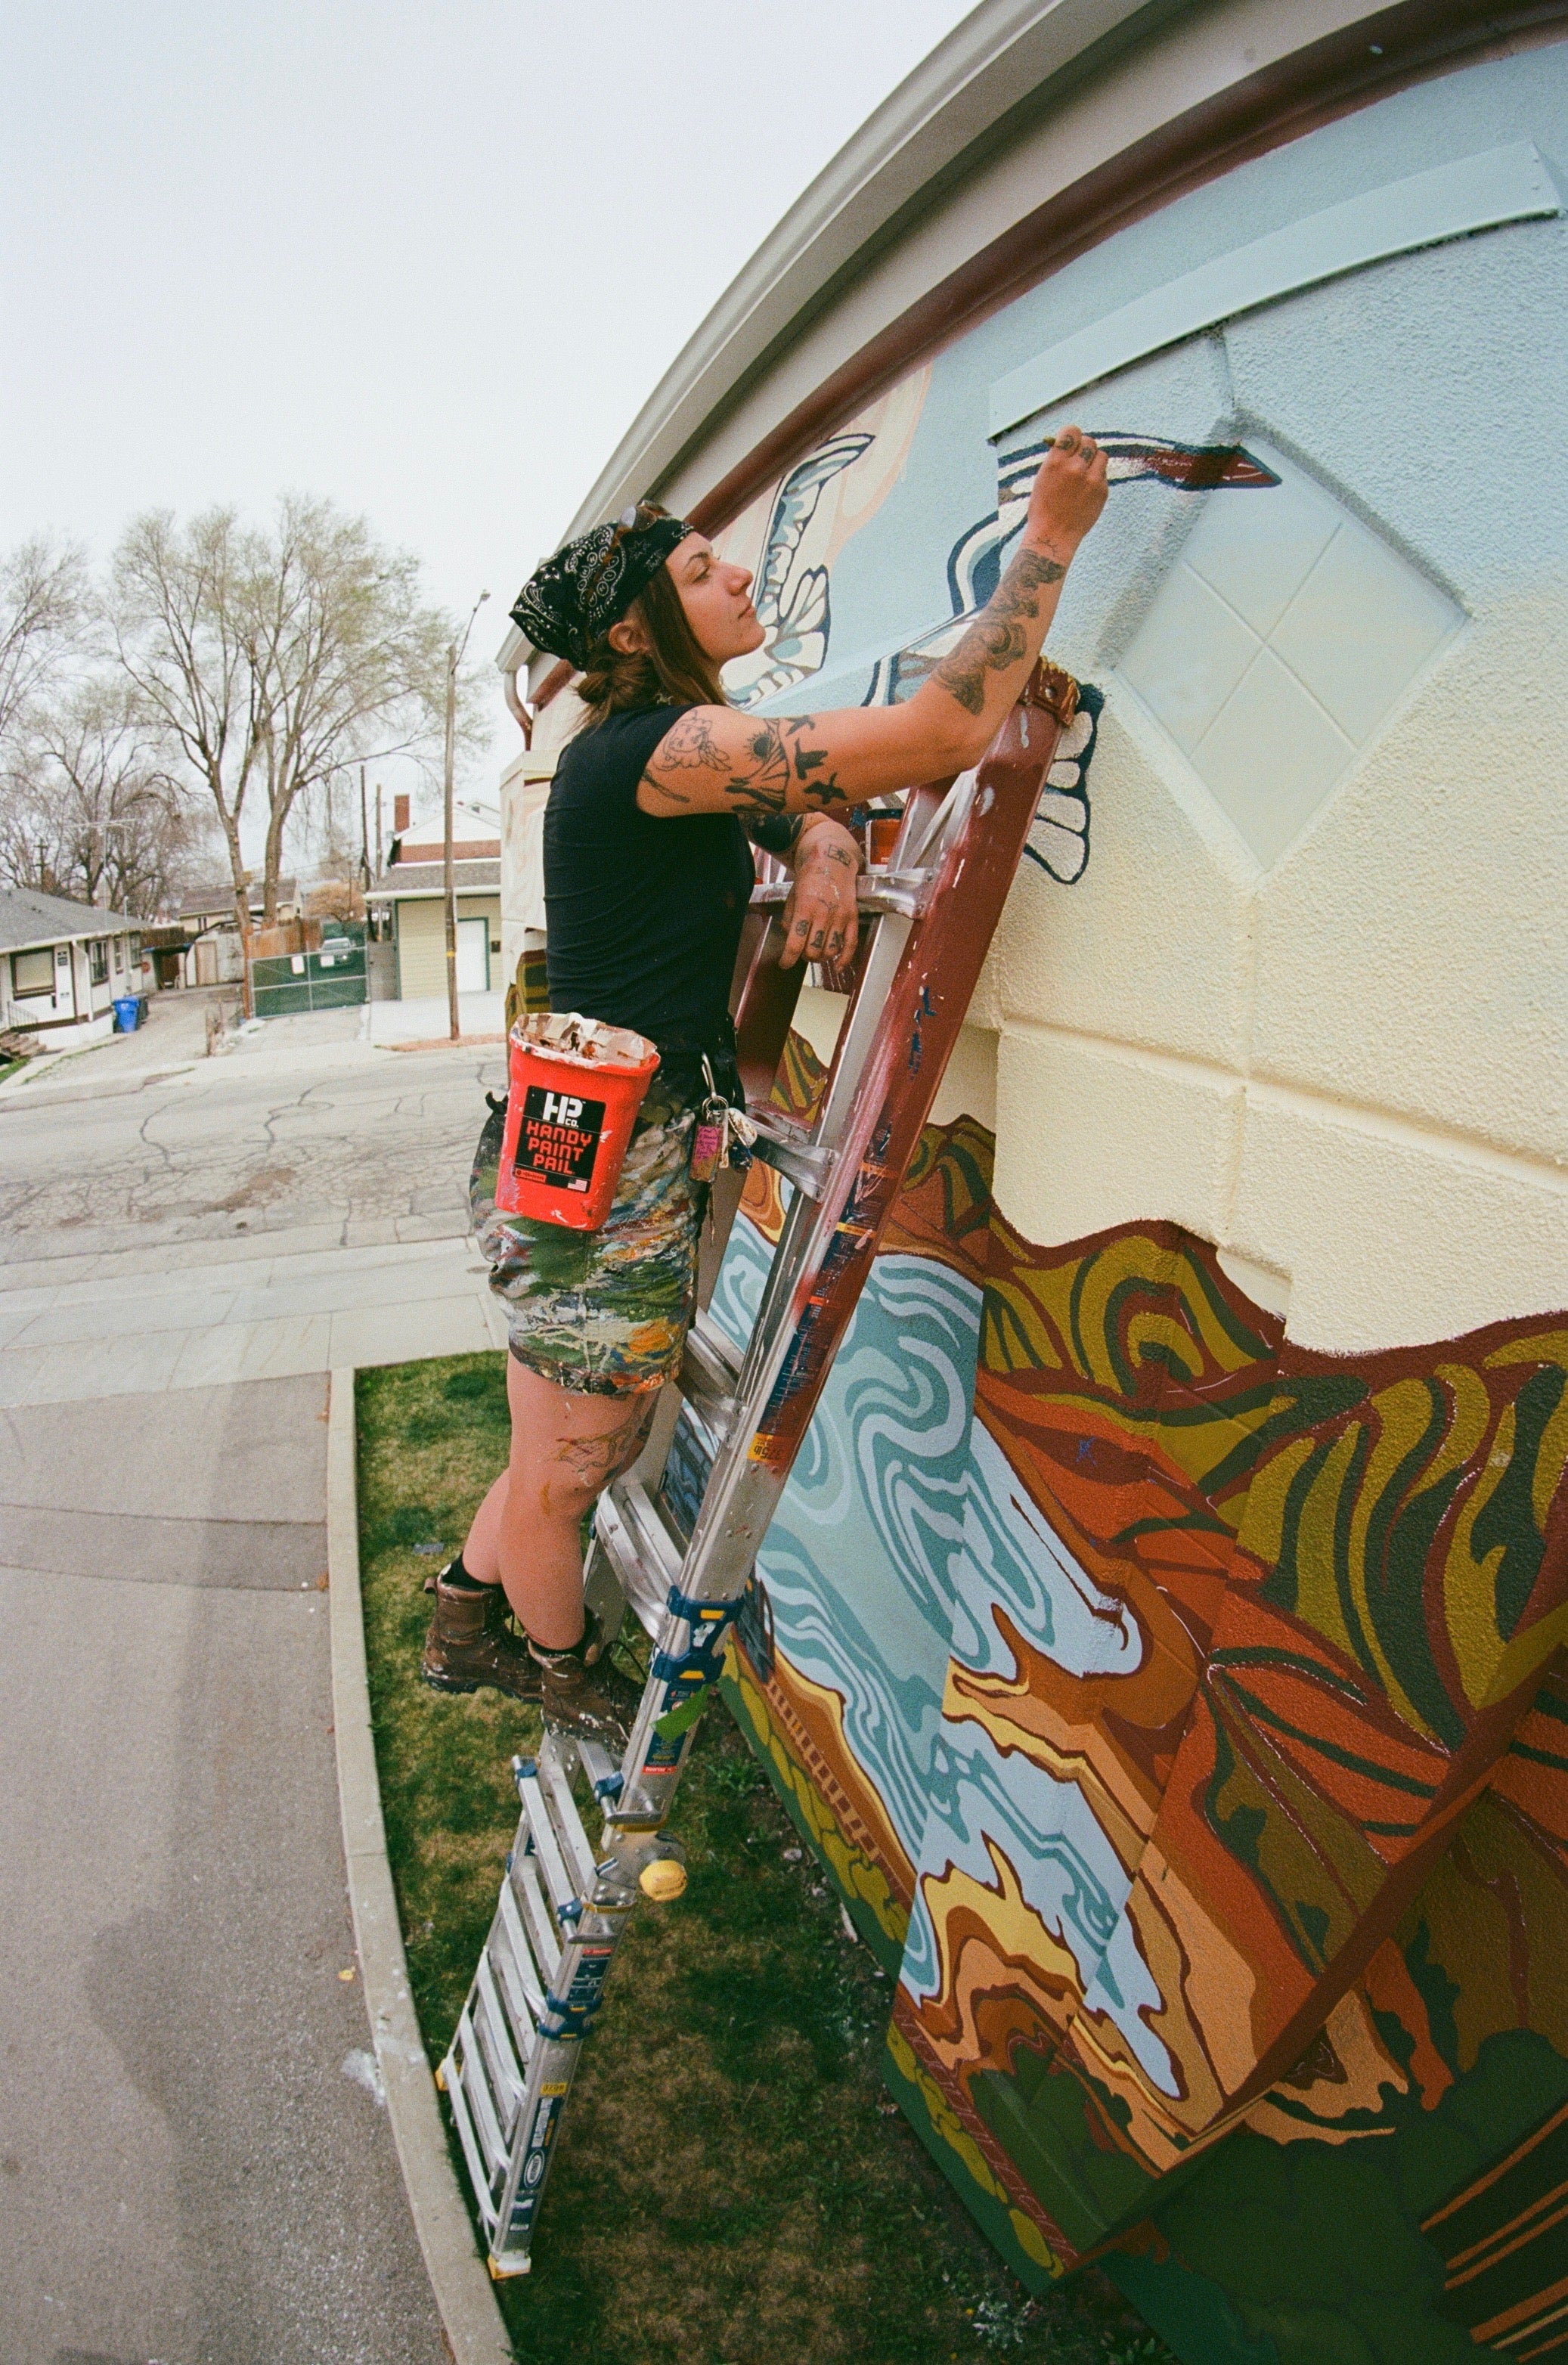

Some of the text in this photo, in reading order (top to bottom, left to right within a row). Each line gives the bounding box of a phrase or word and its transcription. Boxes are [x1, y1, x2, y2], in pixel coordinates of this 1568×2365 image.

[542, 1092, 583, 1124] HP
[526, 1121, 592, 1147] HANDY
[528, 1137, 584, 1161] PAINT
[533, 1154, 573, 1174] PAIL
